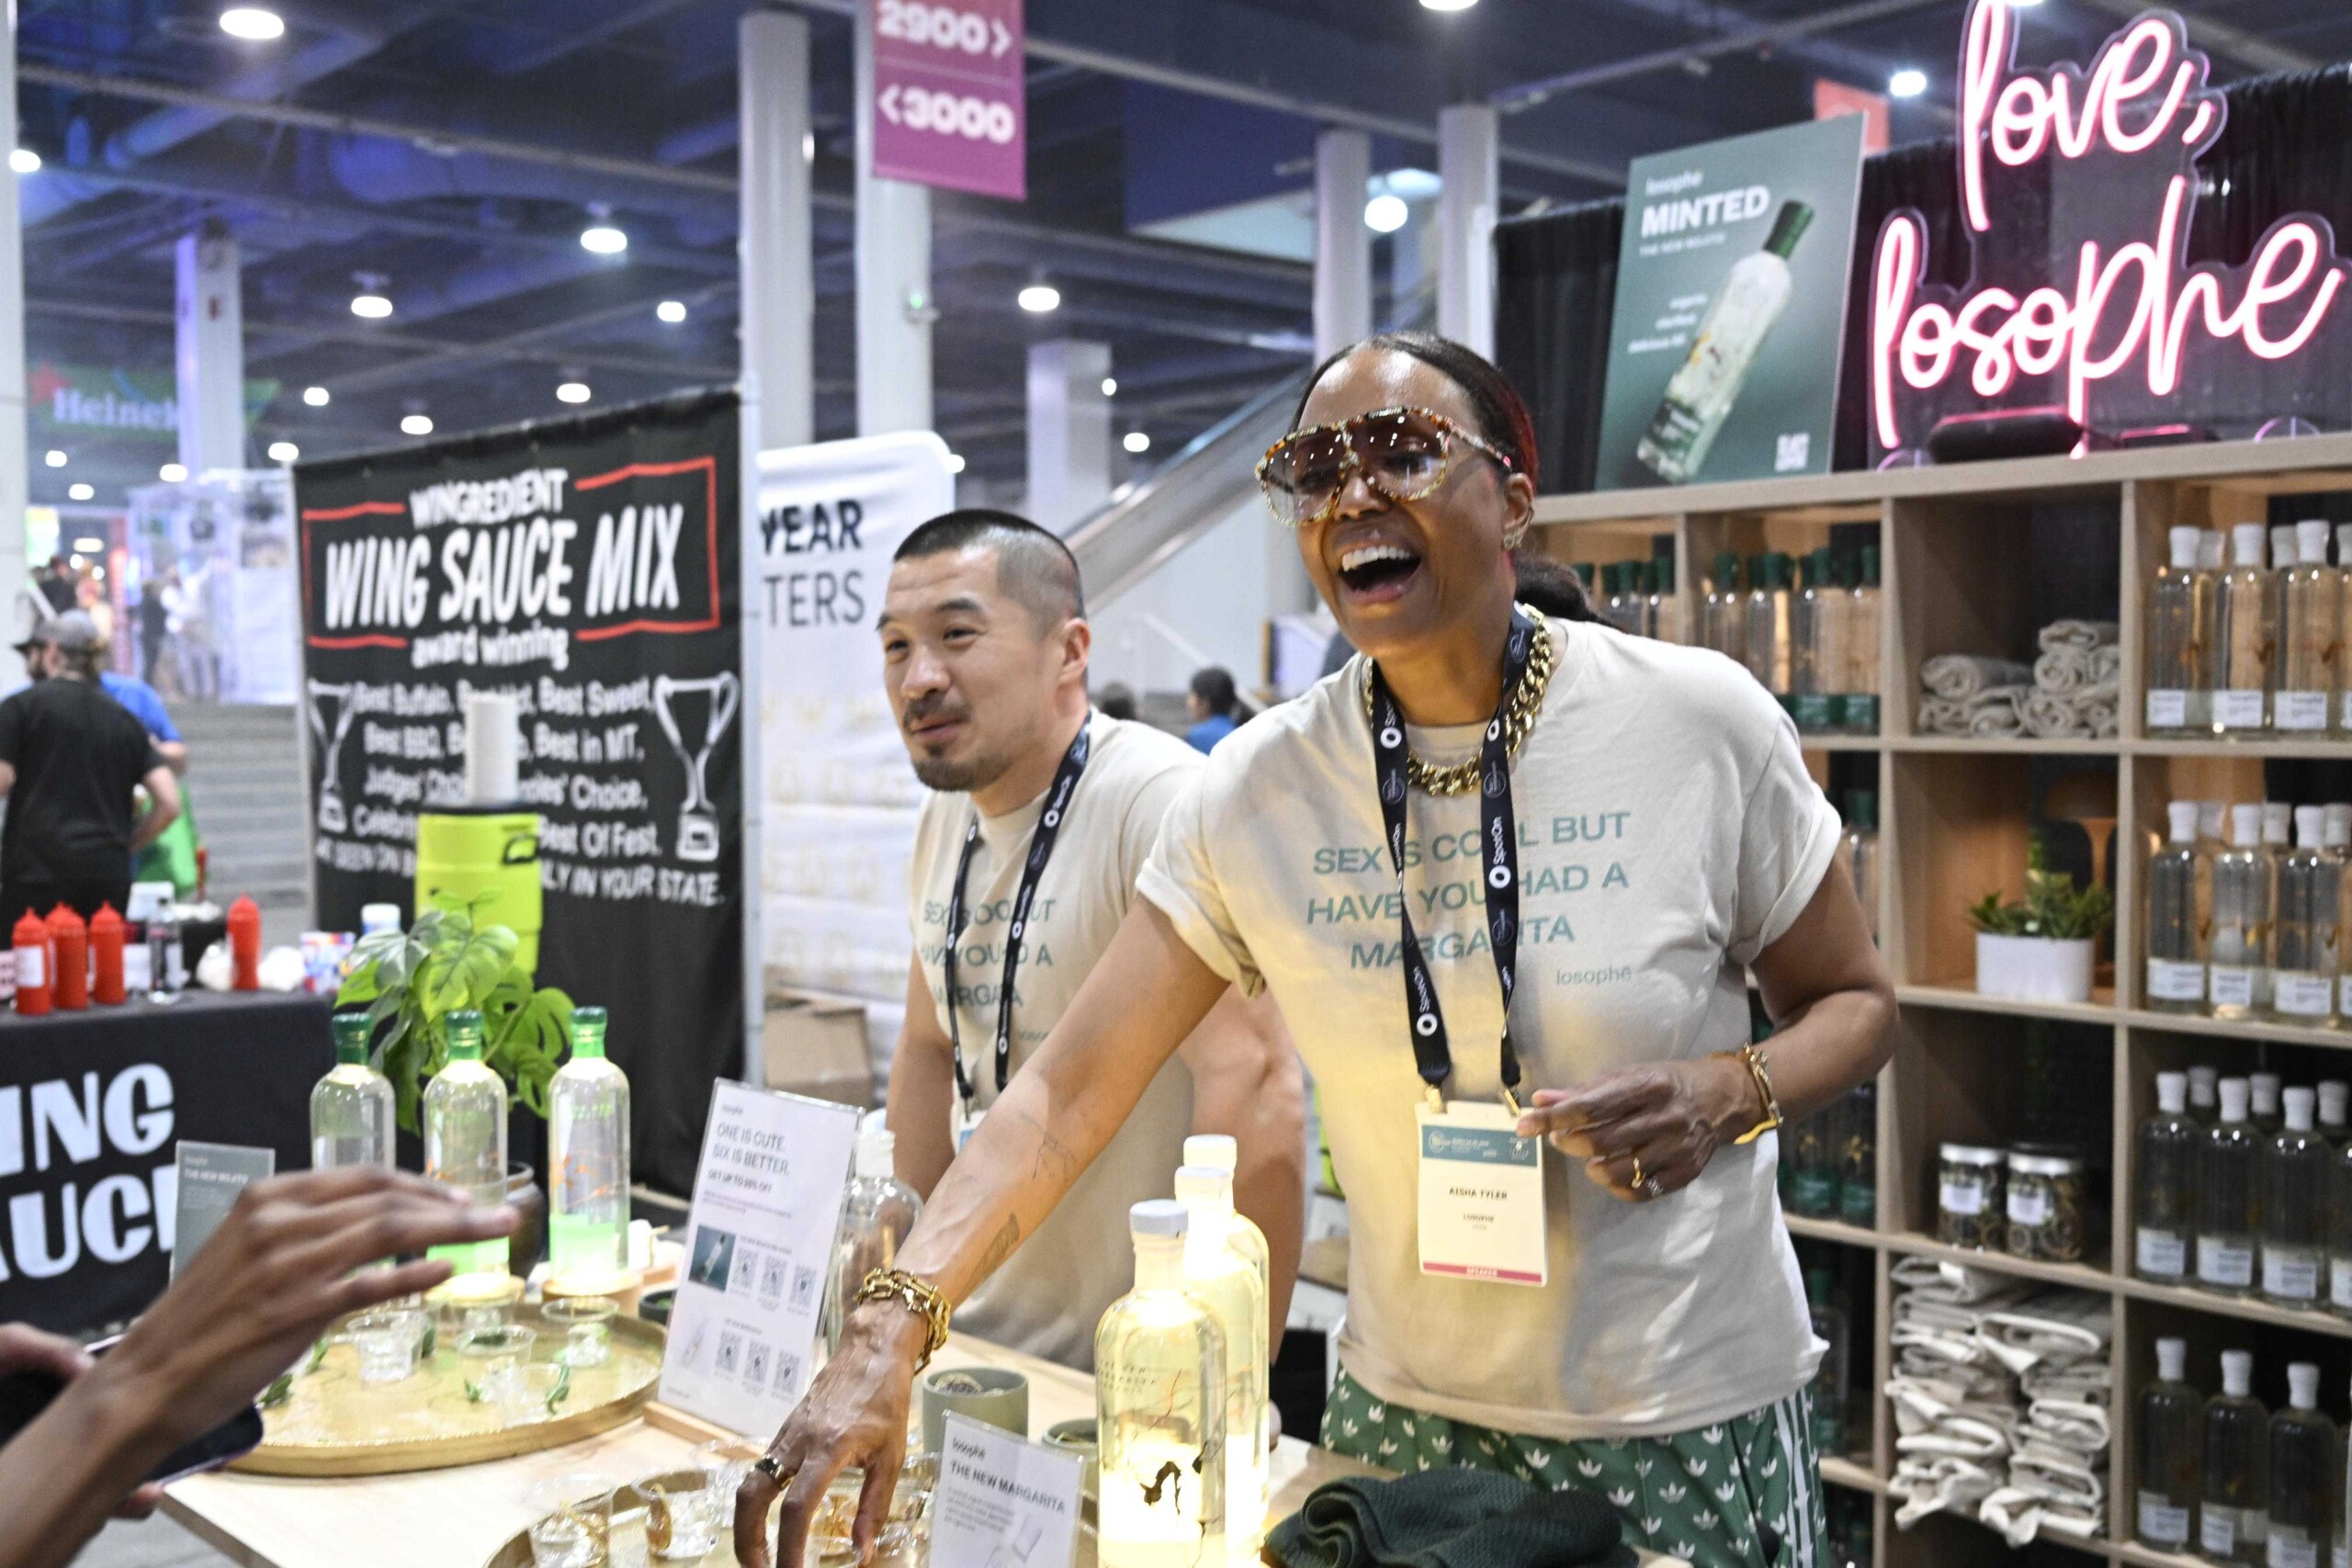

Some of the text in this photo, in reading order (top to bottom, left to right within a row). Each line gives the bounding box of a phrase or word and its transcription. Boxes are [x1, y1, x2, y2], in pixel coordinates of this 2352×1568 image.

[877, 0, 989, 54] 2900
[901, 85, 1016, 145] 3000
[1962, 0, 2216, 232] love,
[1642, 186, 1770, 238] MINTED
[53, 386, 178, 431] Heinek
[410, 468, 569, 529] WINGREDIENT
[760, 499, 863, 556] YEAR
[325, 502, 684, 628] WING SAUCE MIX
[411, 619, 570, 671] award winning
[538, 675, 584, 716] Best
[363, 721, 401, 756] Best
[534, 721, 579, 762] Best
[581, 728, 603, 764] in
[582, 821, 610, 859] Of
[1313, 811, 1631, 875] SEX S COL BUT
[571, 864, 596, 897] IN
[598, 863, 655, 900] YOUR
[1306, 892, 1406, 926] HAVE
[1601, 862, 1630, 889] A
[1351, 916, 1576, 971] MARGAITA
[0, 1063, 175, 1177] ING
[717, 1122, 741, 1141] ONE
[741, 1127, 753, 1143] IS
[712, 1143, 730, 1161] SIX
[731, 1147, 743, 1164] IS
[1449, 1185, 1507, 1201] AISHA TYLER
[949, 1460, 1065, 1513] THE NEW MARGARITA
